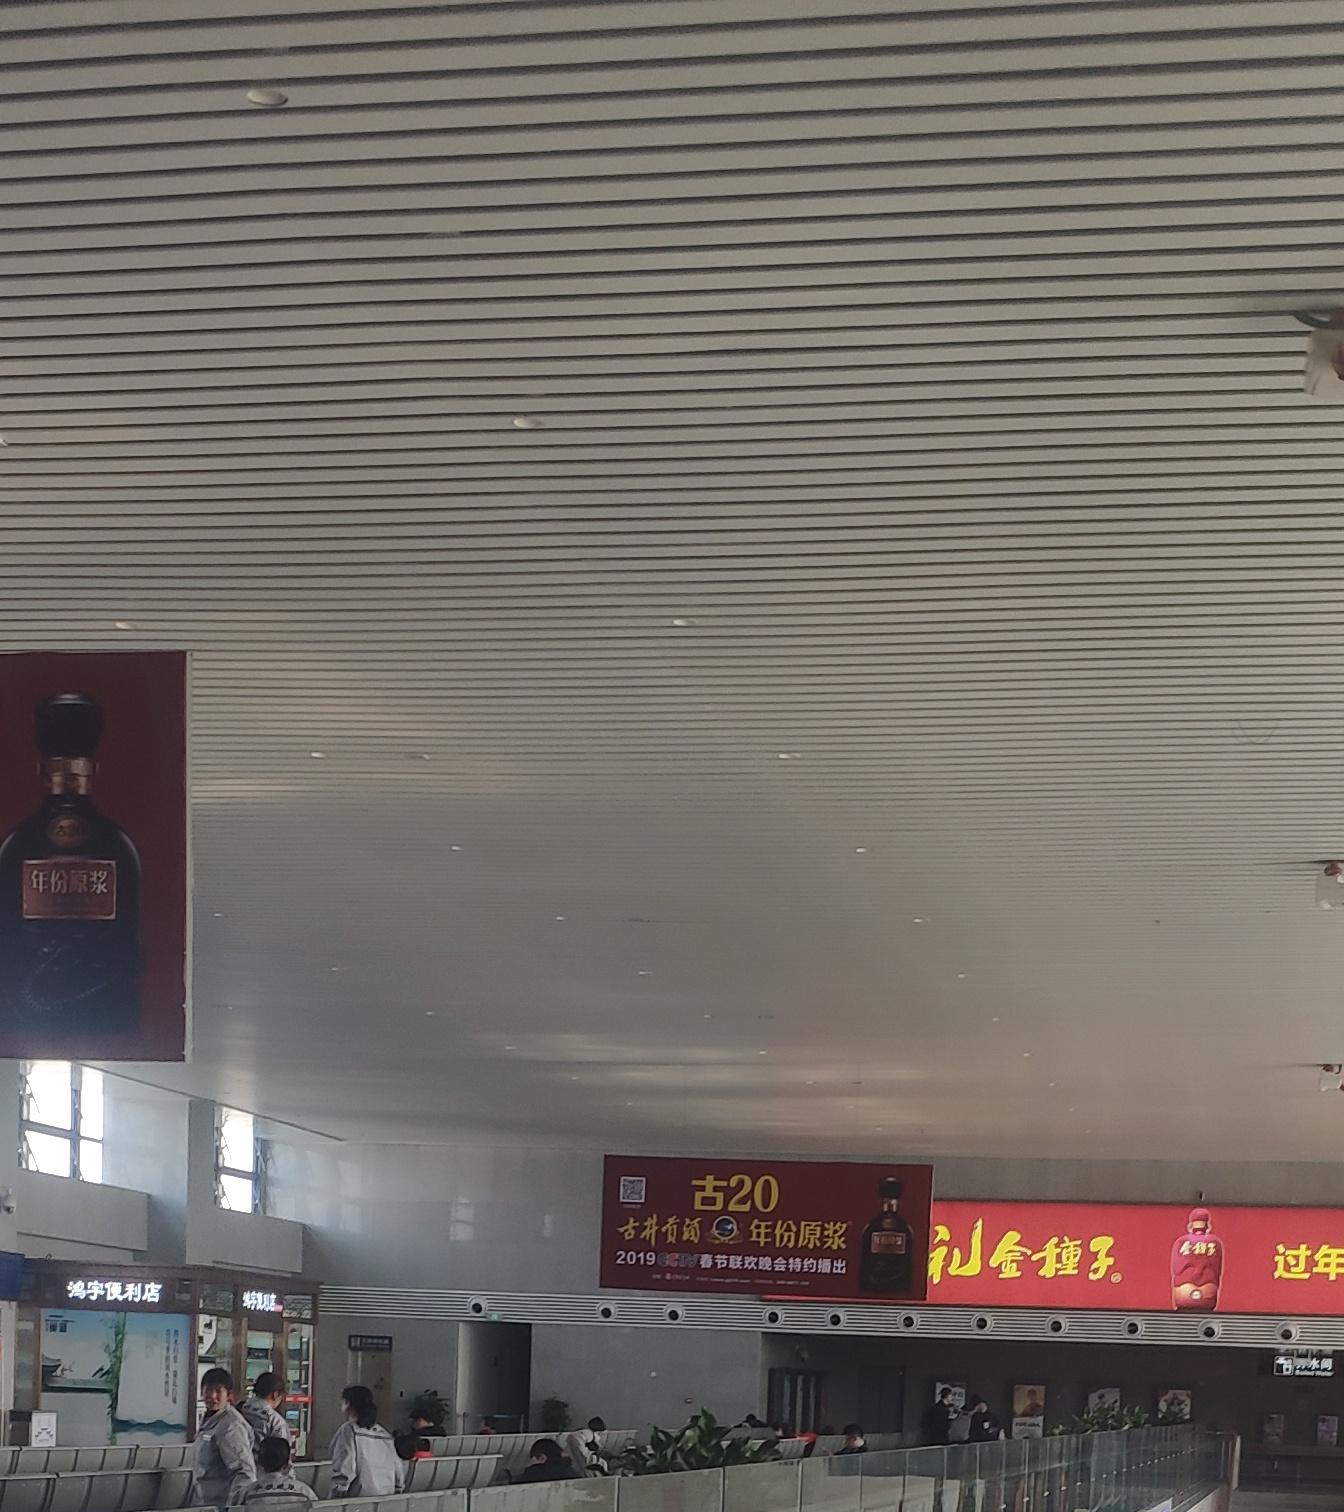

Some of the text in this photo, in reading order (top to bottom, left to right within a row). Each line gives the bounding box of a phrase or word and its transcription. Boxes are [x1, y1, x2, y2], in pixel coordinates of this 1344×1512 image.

[691, 1174, 780, 1213] 古20
[749, 1218, 848, 1250] 年份原浆
